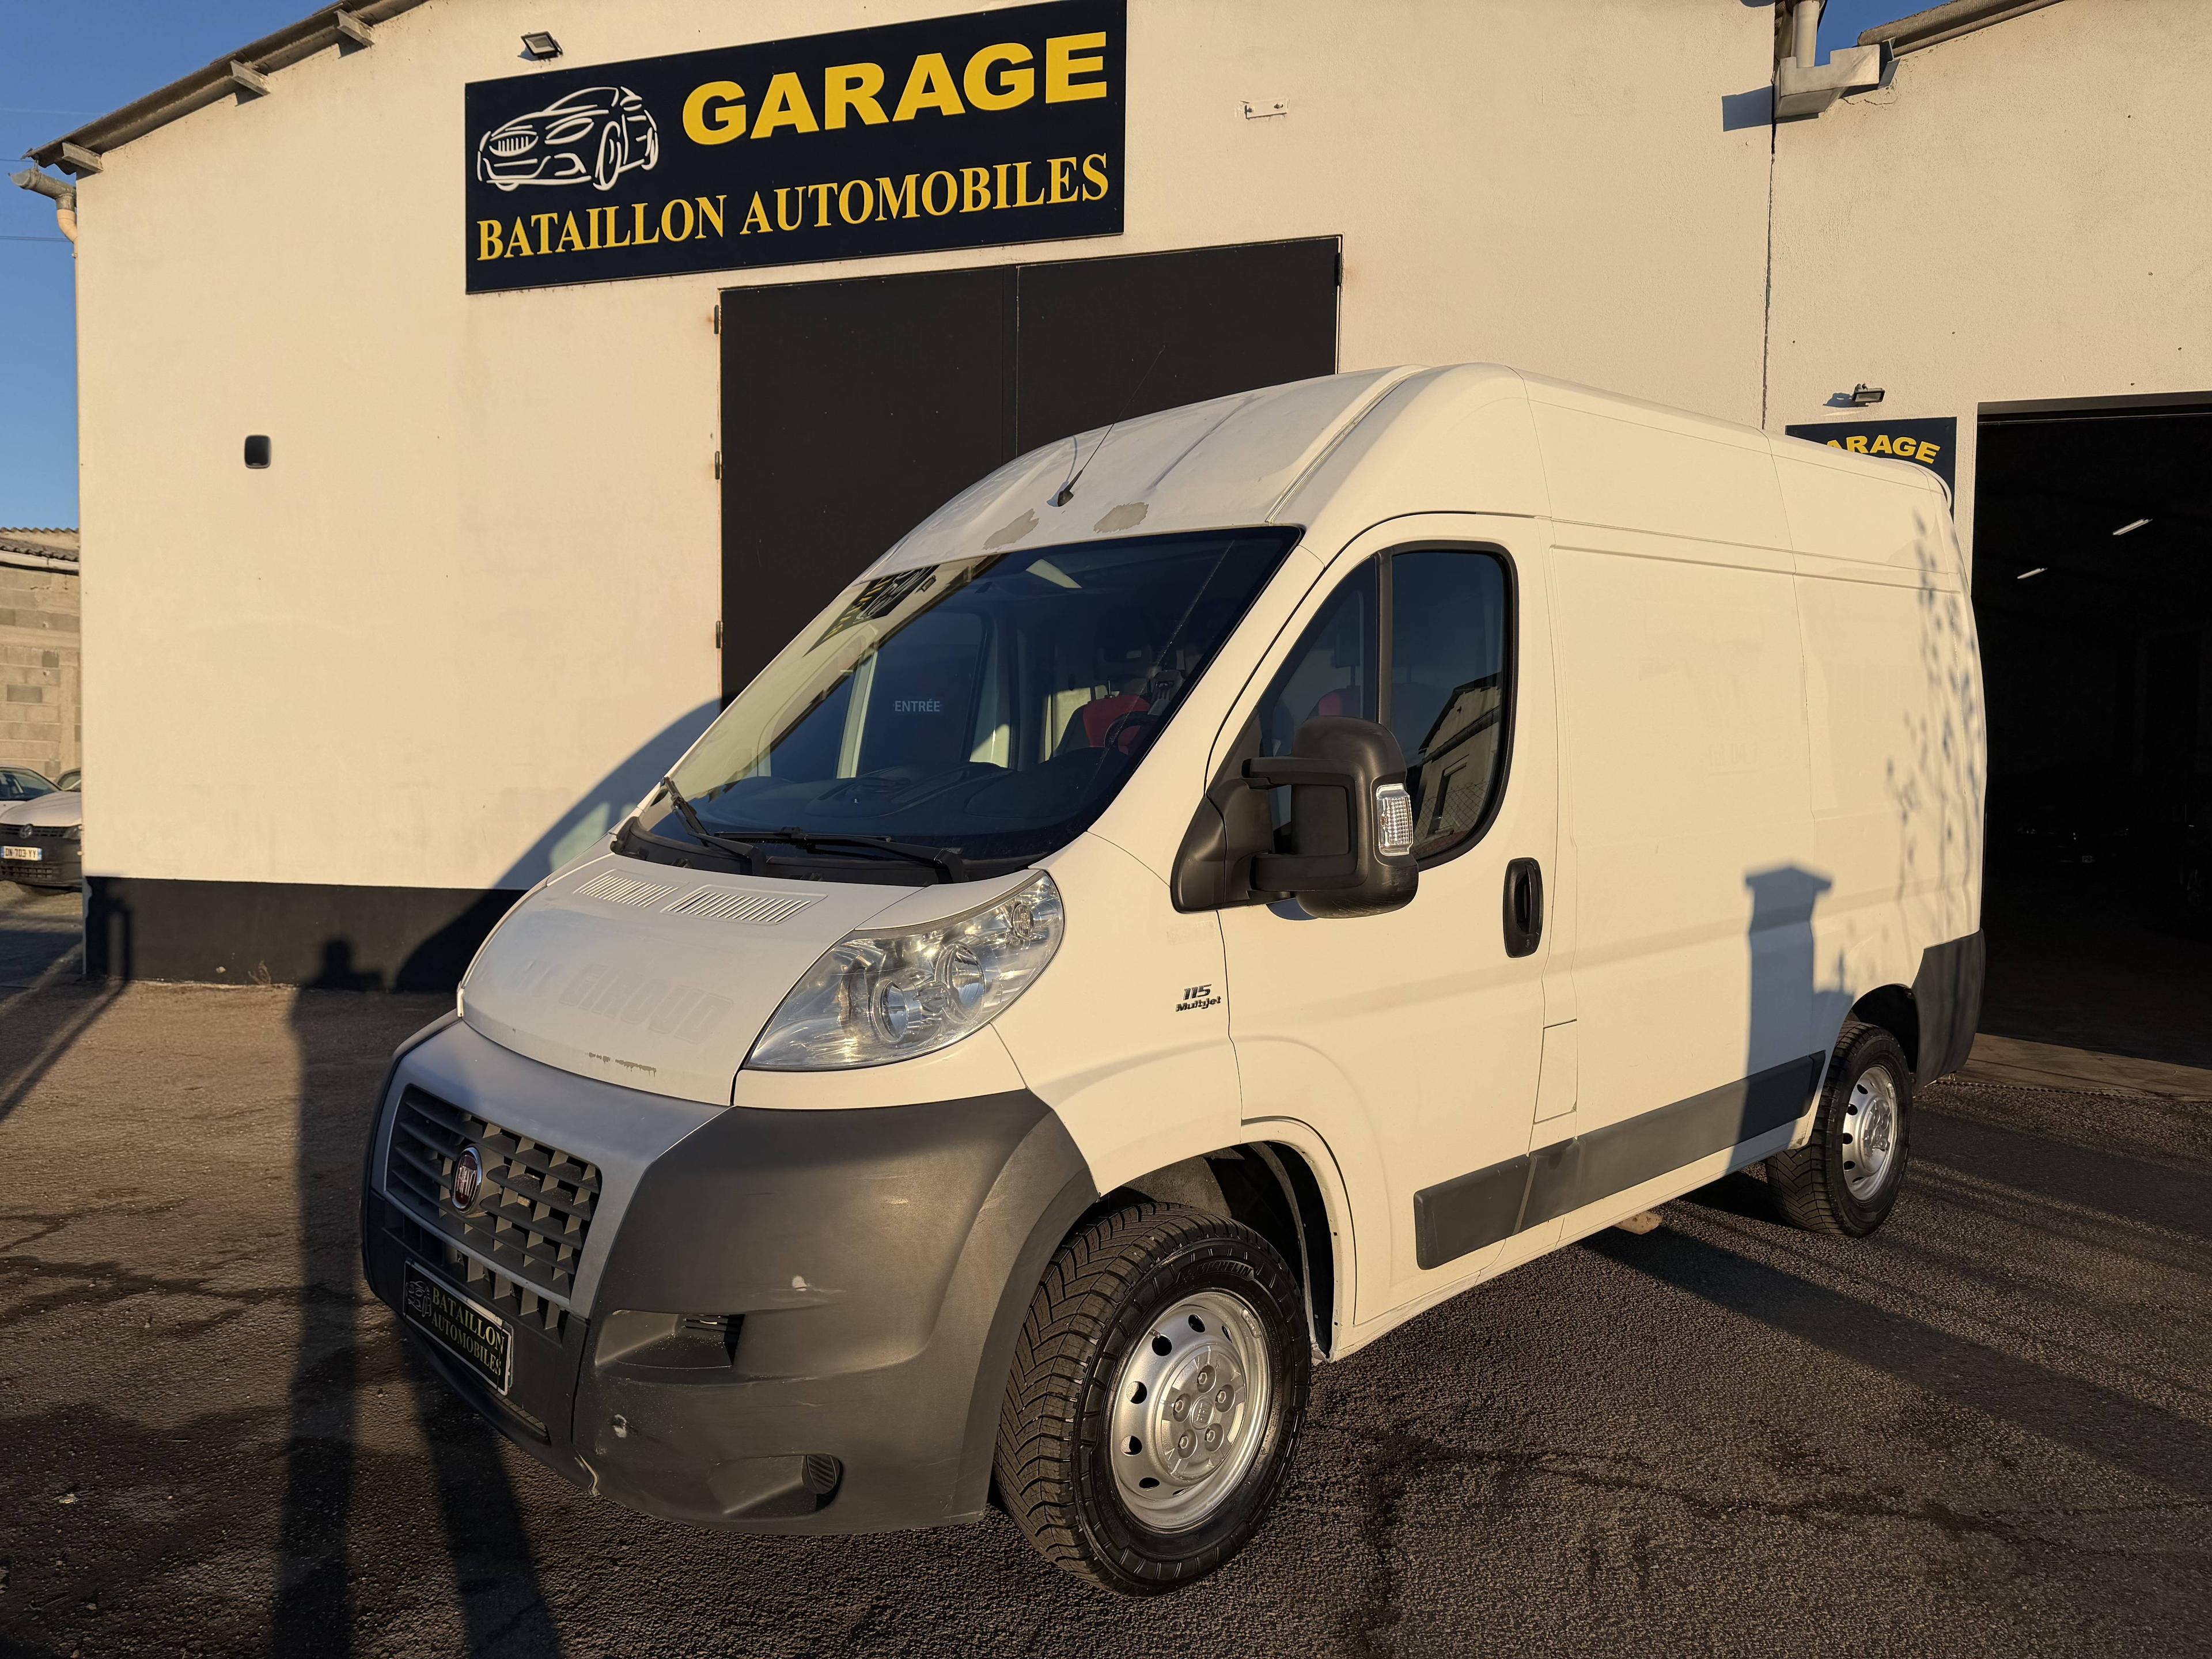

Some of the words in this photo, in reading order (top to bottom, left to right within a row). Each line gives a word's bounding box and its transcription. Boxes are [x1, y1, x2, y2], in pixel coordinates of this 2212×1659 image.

[683, 31, 1108, 146] GARAGE
[477, 194, 726, 262] BATAILLON
[739, 152, 1109, 236] AUTOMOBILES
[895, 698, 941, 712] ENTRÉE
[1183, 983, 1212, 1001] 115
[431, 1311, 501, 1376] AUTOMOBILES
[432, 1286, 504, 1354] BATAILLON
